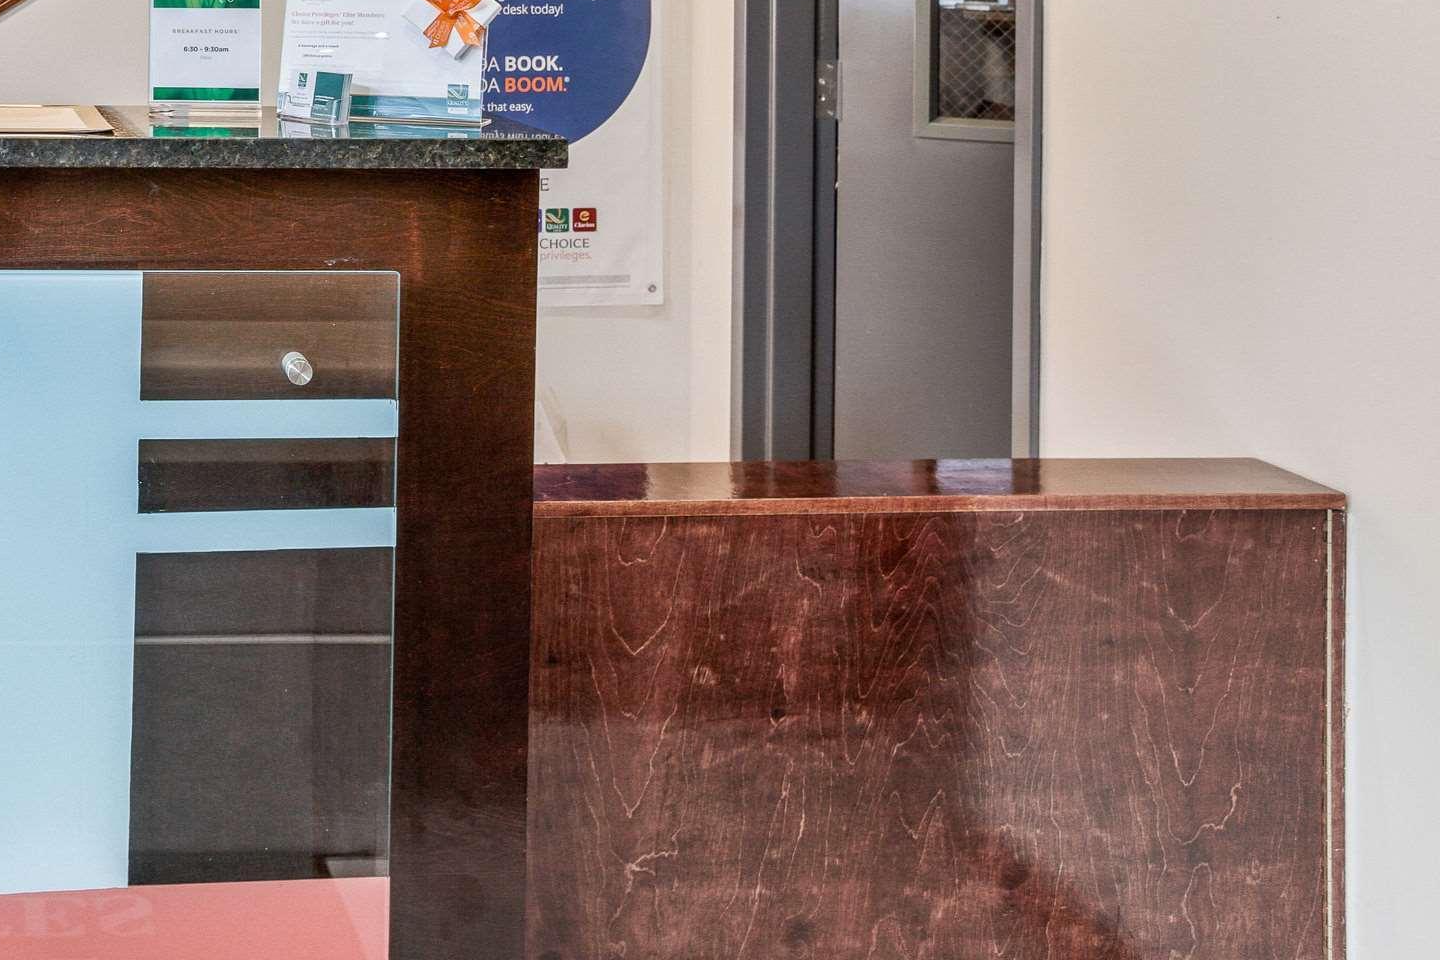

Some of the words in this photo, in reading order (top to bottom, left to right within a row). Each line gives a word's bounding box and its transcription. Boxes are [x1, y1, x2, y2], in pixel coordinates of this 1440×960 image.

[502, 4, 529, 15] desk
[530, 4, 564, 17] today!
[504, 54, 563, 72] BOOK.
[487, 102, 508, 112] that
[509, 103, 534, 114] easy.
[540, 238, 591, 250] CHOICE
